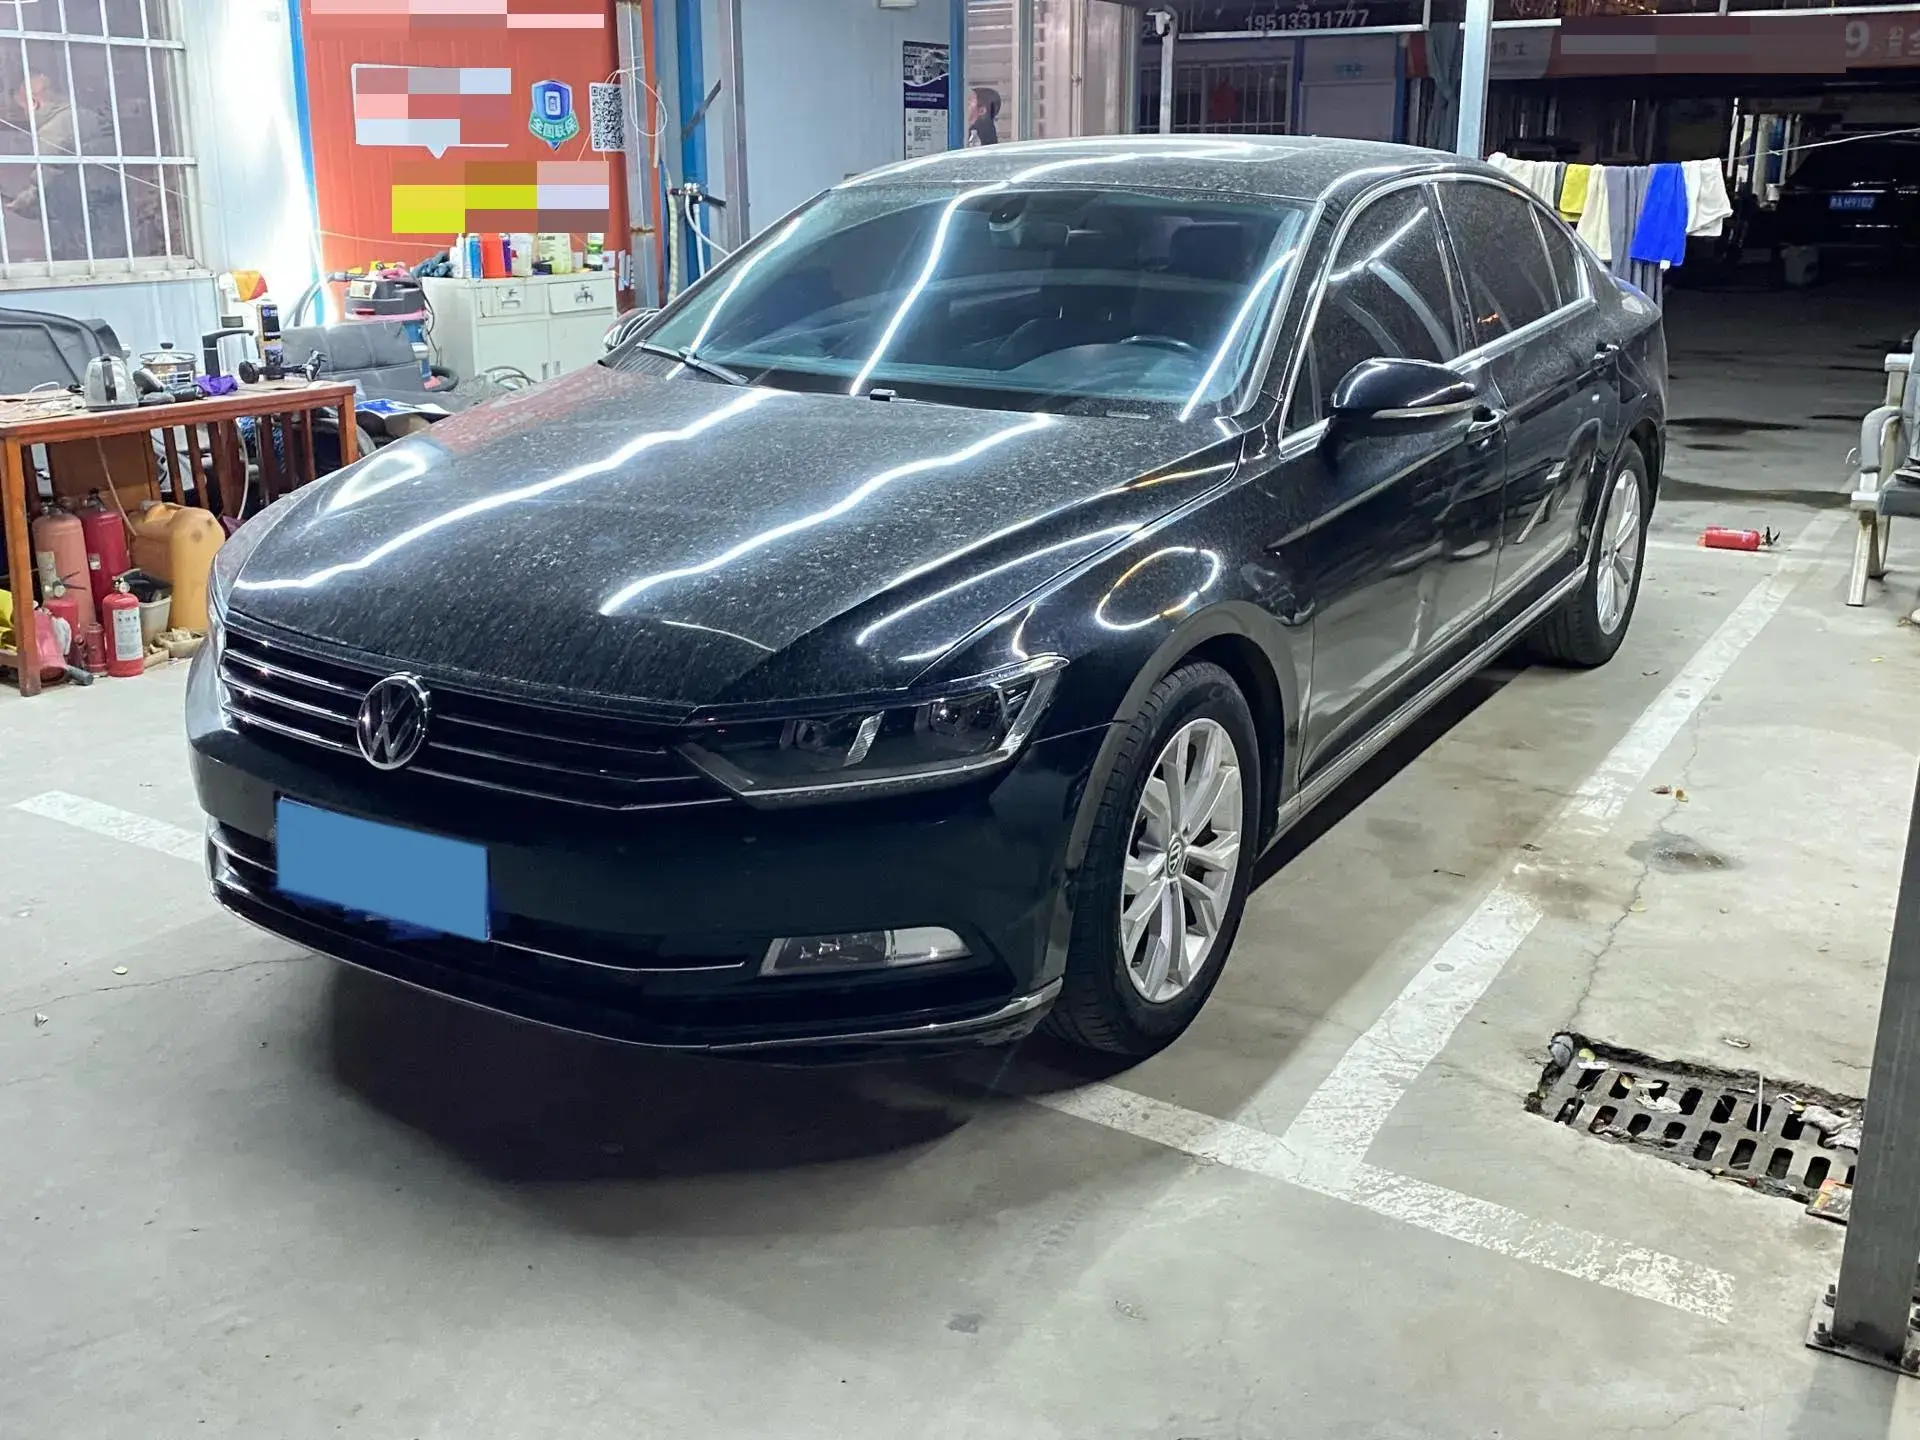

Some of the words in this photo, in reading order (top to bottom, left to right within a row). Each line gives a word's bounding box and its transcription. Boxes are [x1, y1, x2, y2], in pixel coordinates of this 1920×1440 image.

[1246, 9, 1370, 31] 19513311777
[530, 117, 578, 139] 全国联保
